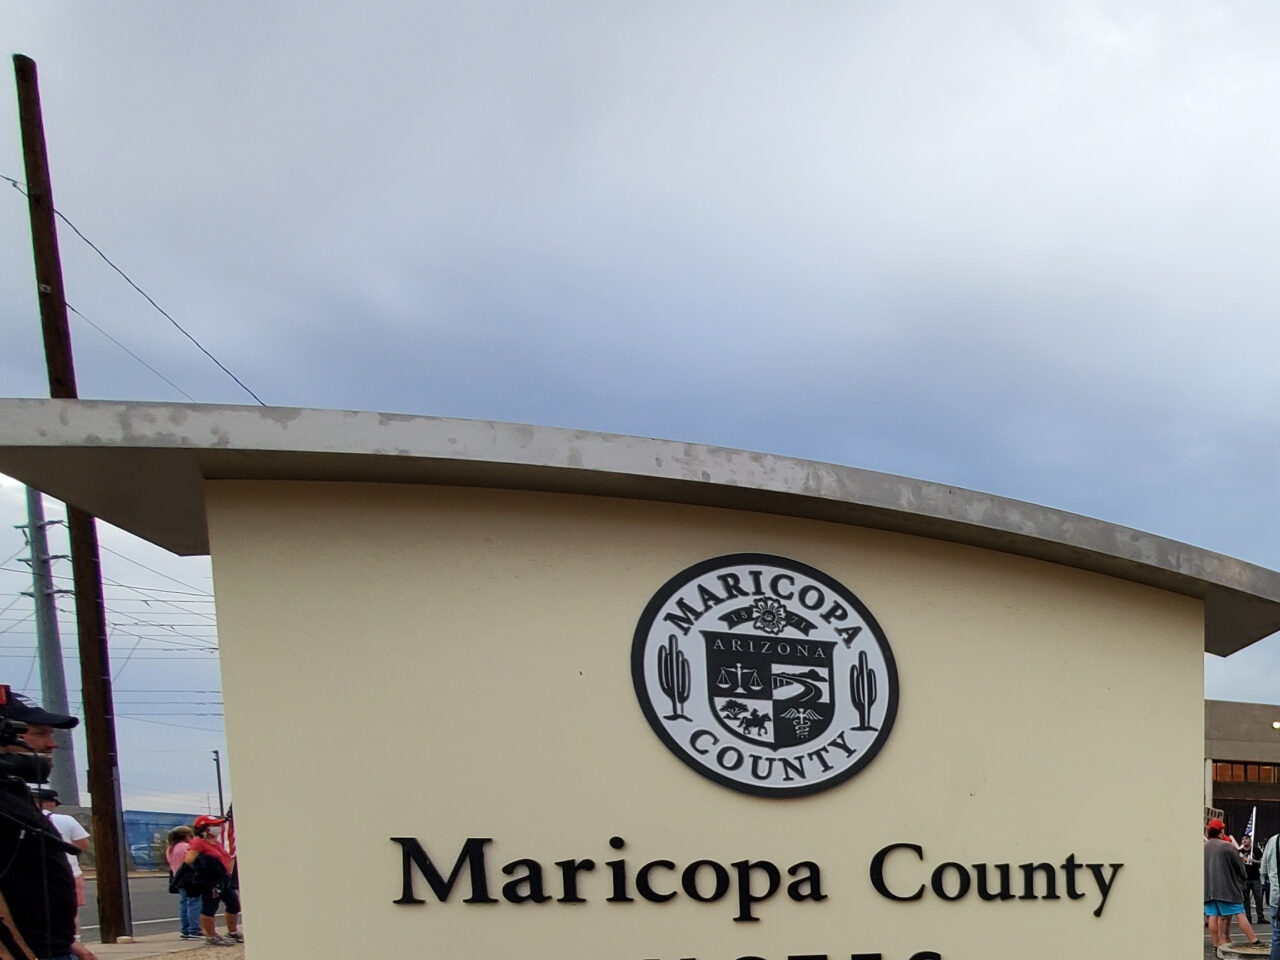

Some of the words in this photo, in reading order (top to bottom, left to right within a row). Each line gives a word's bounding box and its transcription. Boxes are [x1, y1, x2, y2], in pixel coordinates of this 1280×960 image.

[663, 570, 863, 649] MARICOPA
[713, 637, 827, 659] ARIZONA
[690, 729, 857, 781] COUNTY
[390, 836, 828, 922] Maricopa
[869, 842, 1125, 918] County
